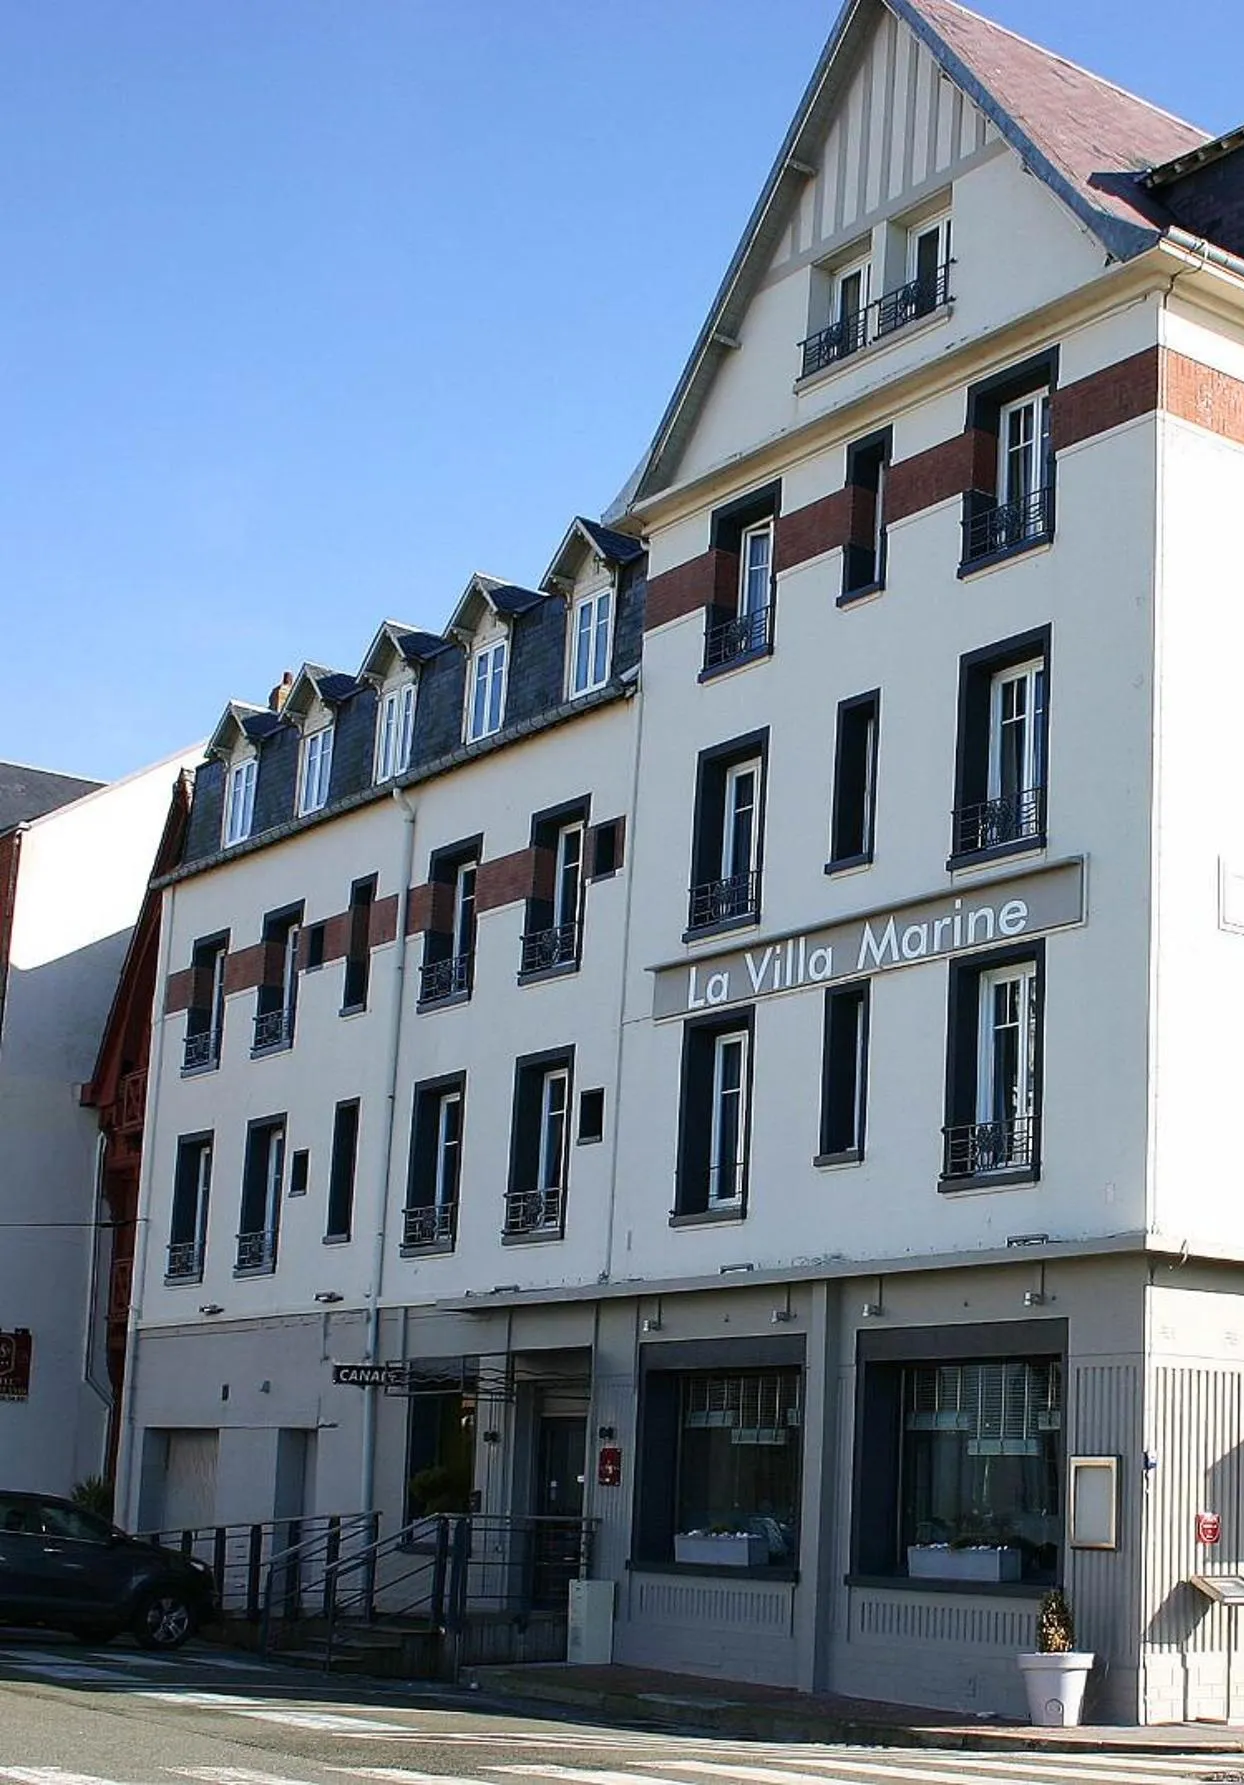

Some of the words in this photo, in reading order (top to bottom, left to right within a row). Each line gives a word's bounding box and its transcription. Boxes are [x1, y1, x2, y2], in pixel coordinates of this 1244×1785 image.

[688, 966, 729, 1010] La
[744, 936, 833, 993] Villa
[857, 898, 1028, 970] Marine
